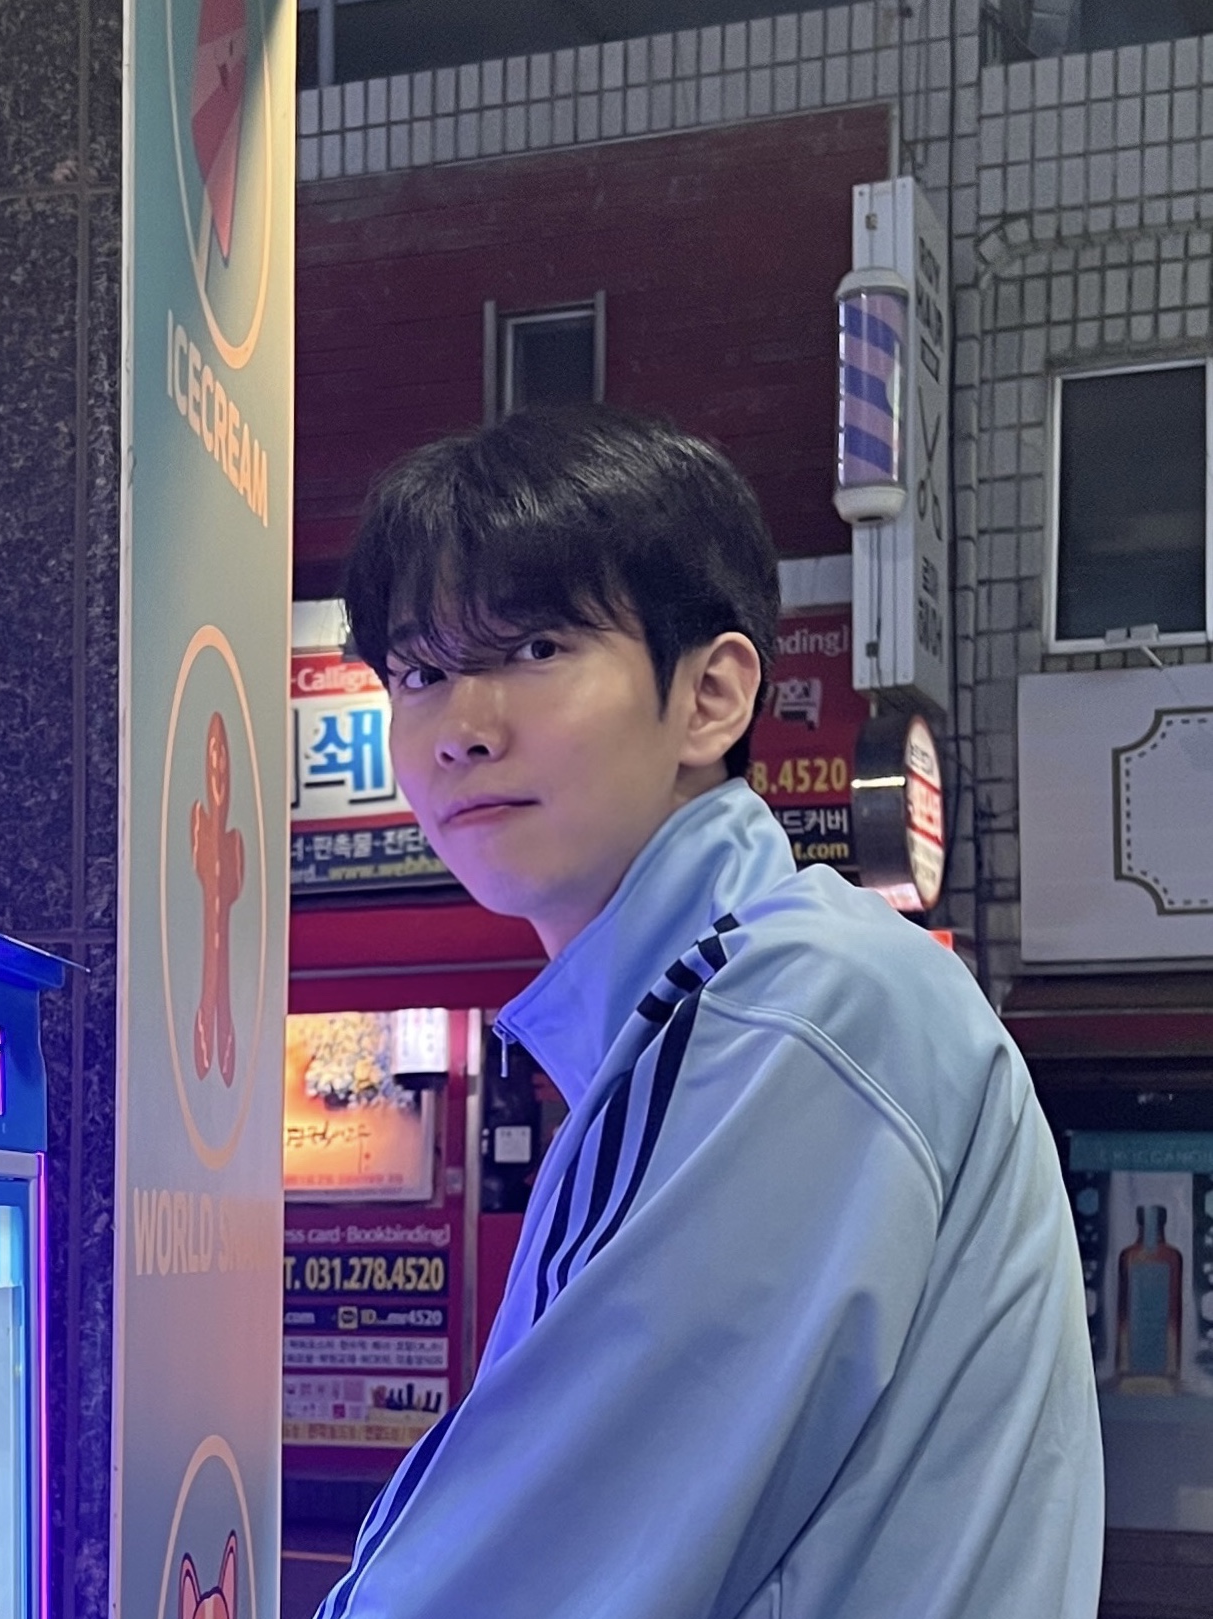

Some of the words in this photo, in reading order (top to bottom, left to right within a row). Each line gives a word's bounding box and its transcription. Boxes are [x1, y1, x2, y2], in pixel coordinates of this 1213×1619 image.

[166, 307, 268, 528] ICECREAM
[775, 808, 850, 836] 드커버
[132, 1186, 213, 1277] WORLD
[304, 1256, 445, 1292] 031.278.4520
